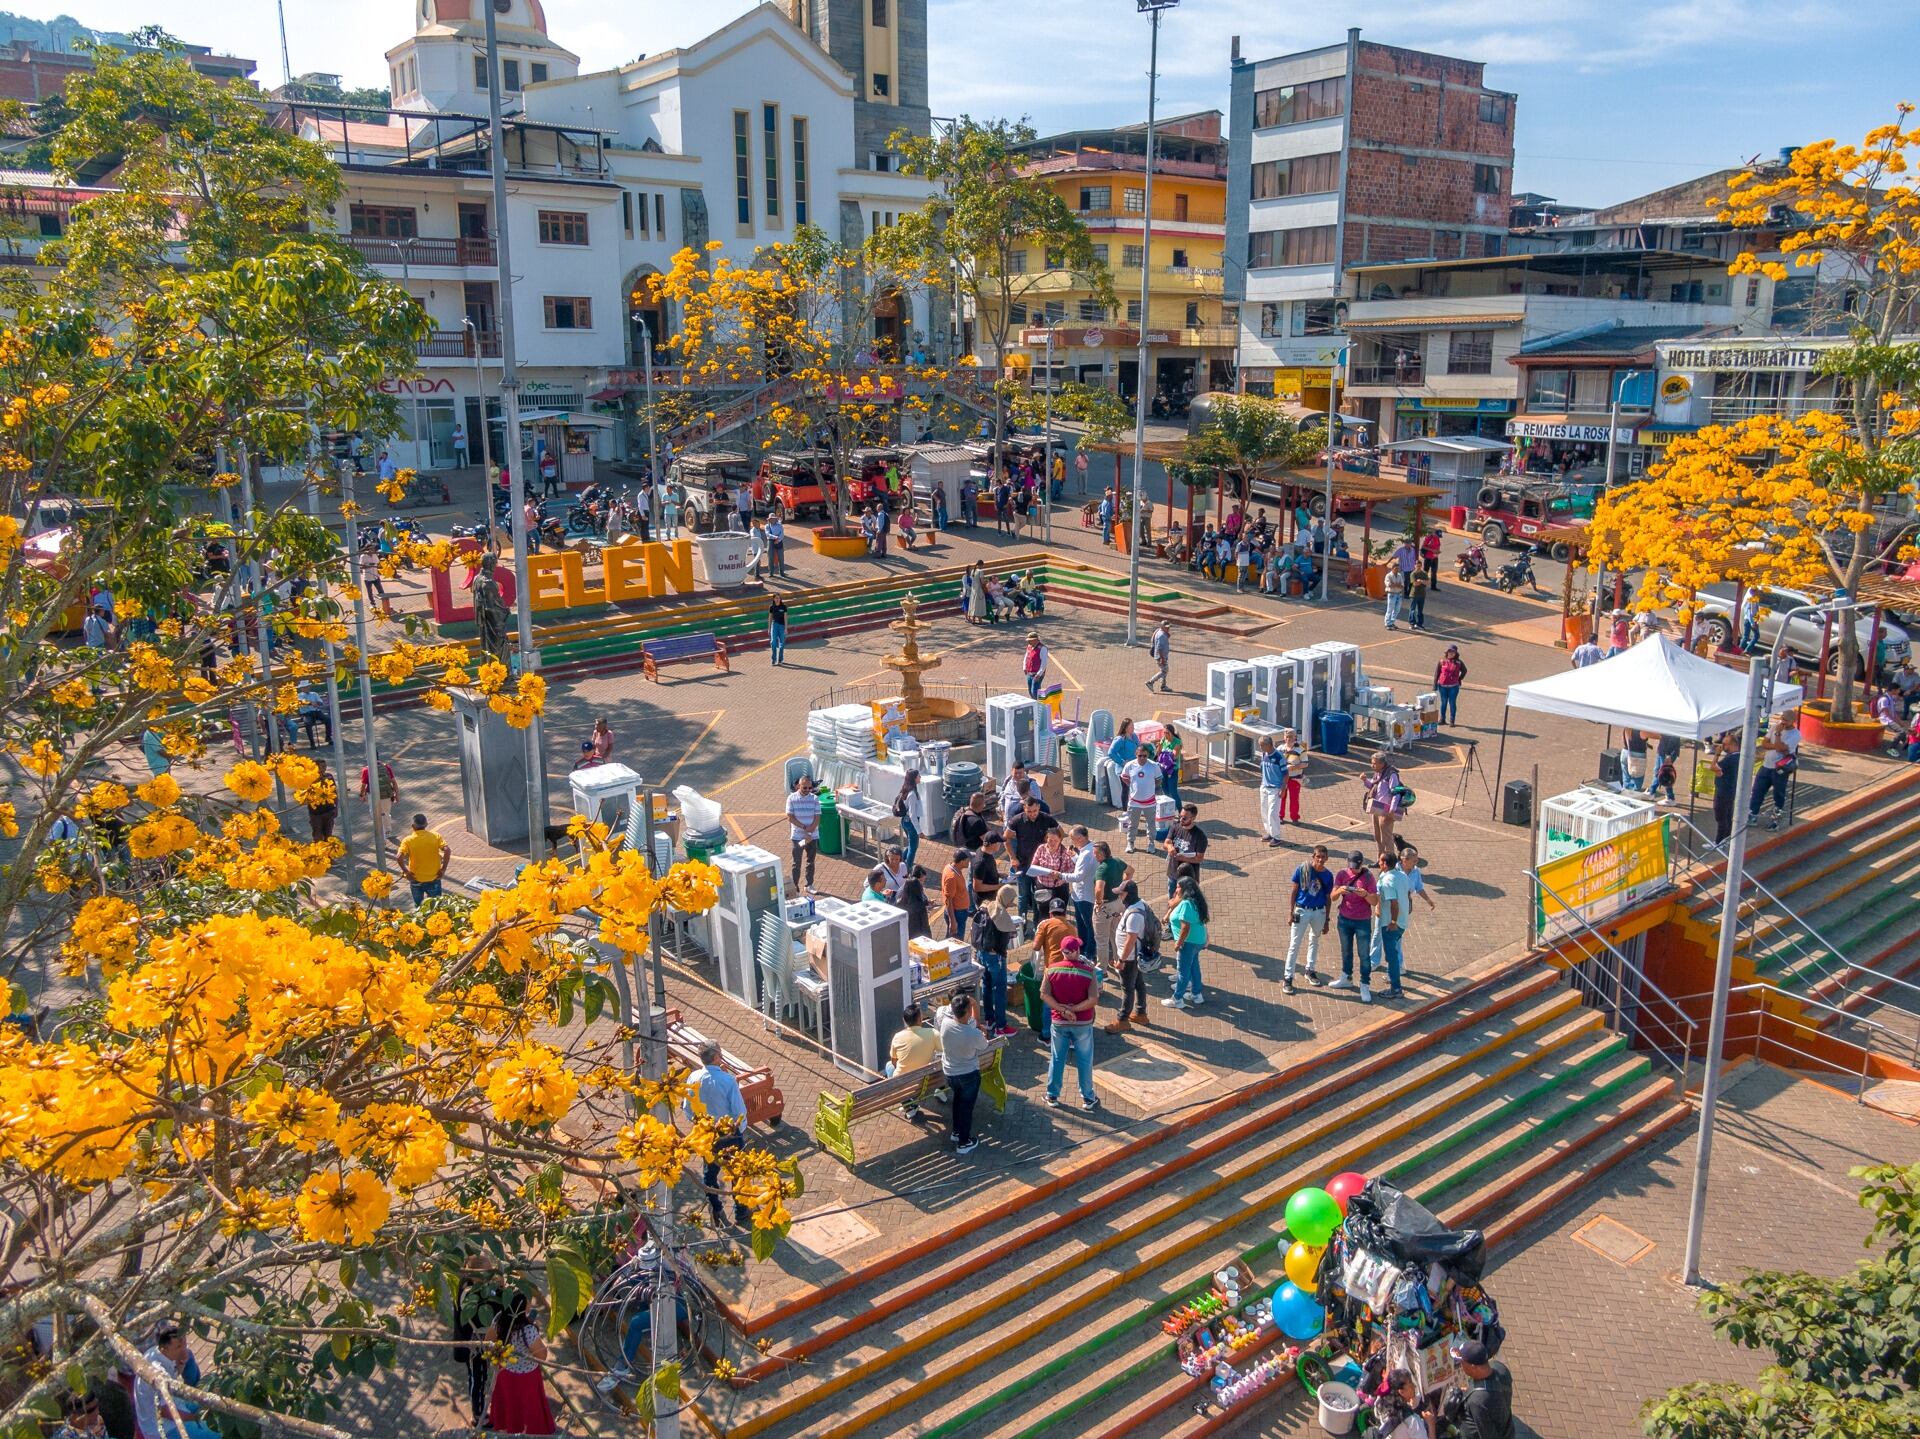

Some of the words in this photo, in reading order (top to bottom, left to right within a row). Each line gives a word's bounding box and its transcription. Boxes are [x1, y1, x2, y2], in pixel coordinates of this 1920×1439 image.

[1668, 350, 1706, 367] HOTEL
[1708, 349, 1806, 367] RESTAURANTE
[1523, 423, 1567, 438] REMATES
[1569, 425, 1580, 439] LA
[1578, 867, 1589, 882] LA
[1592, 849, 1625, 876] TIENDA
[1578, 884, 1590, 900] DE
[1592, 876, 1602, 892] MI
